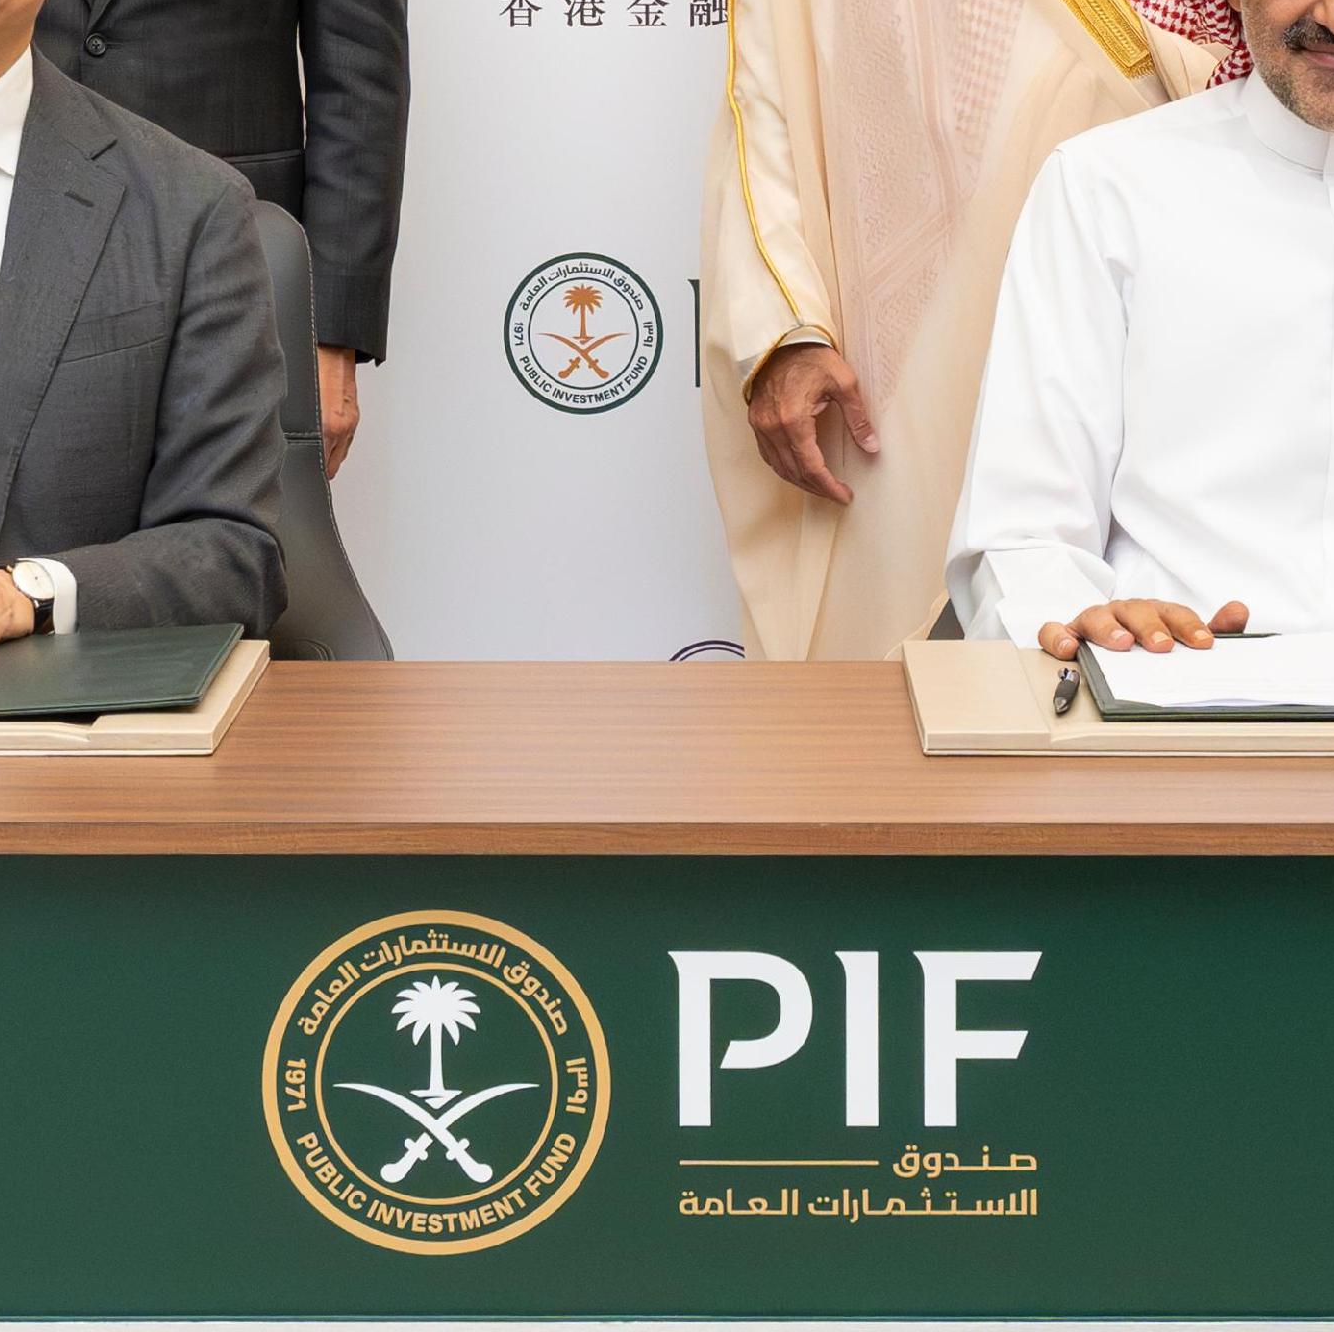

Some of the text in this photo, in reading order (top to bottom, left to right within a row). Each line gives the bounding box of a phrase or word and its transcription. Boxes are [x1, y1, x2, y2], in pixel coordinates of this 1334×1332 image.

[520, 261, 643, 311] صندوق الاستثمارات العامة
[514, 322, 524, 346] 1971
[519, 355, 648, 403] PUBLIC INVESTMENT FUND
[297, 929, 568, 1036] صندوق الاستثمارات العامة
[667, 950, 1043, 1127] PIF
[285, 1058, 307, 1111] 1971
[297, 1132, 577, 1234] PUBLIC INVESTMENT FUND
[892, 1144, 1037, 1178] صندوق
[679, 1187, 1038, 1224] الاستثمارات العامة
